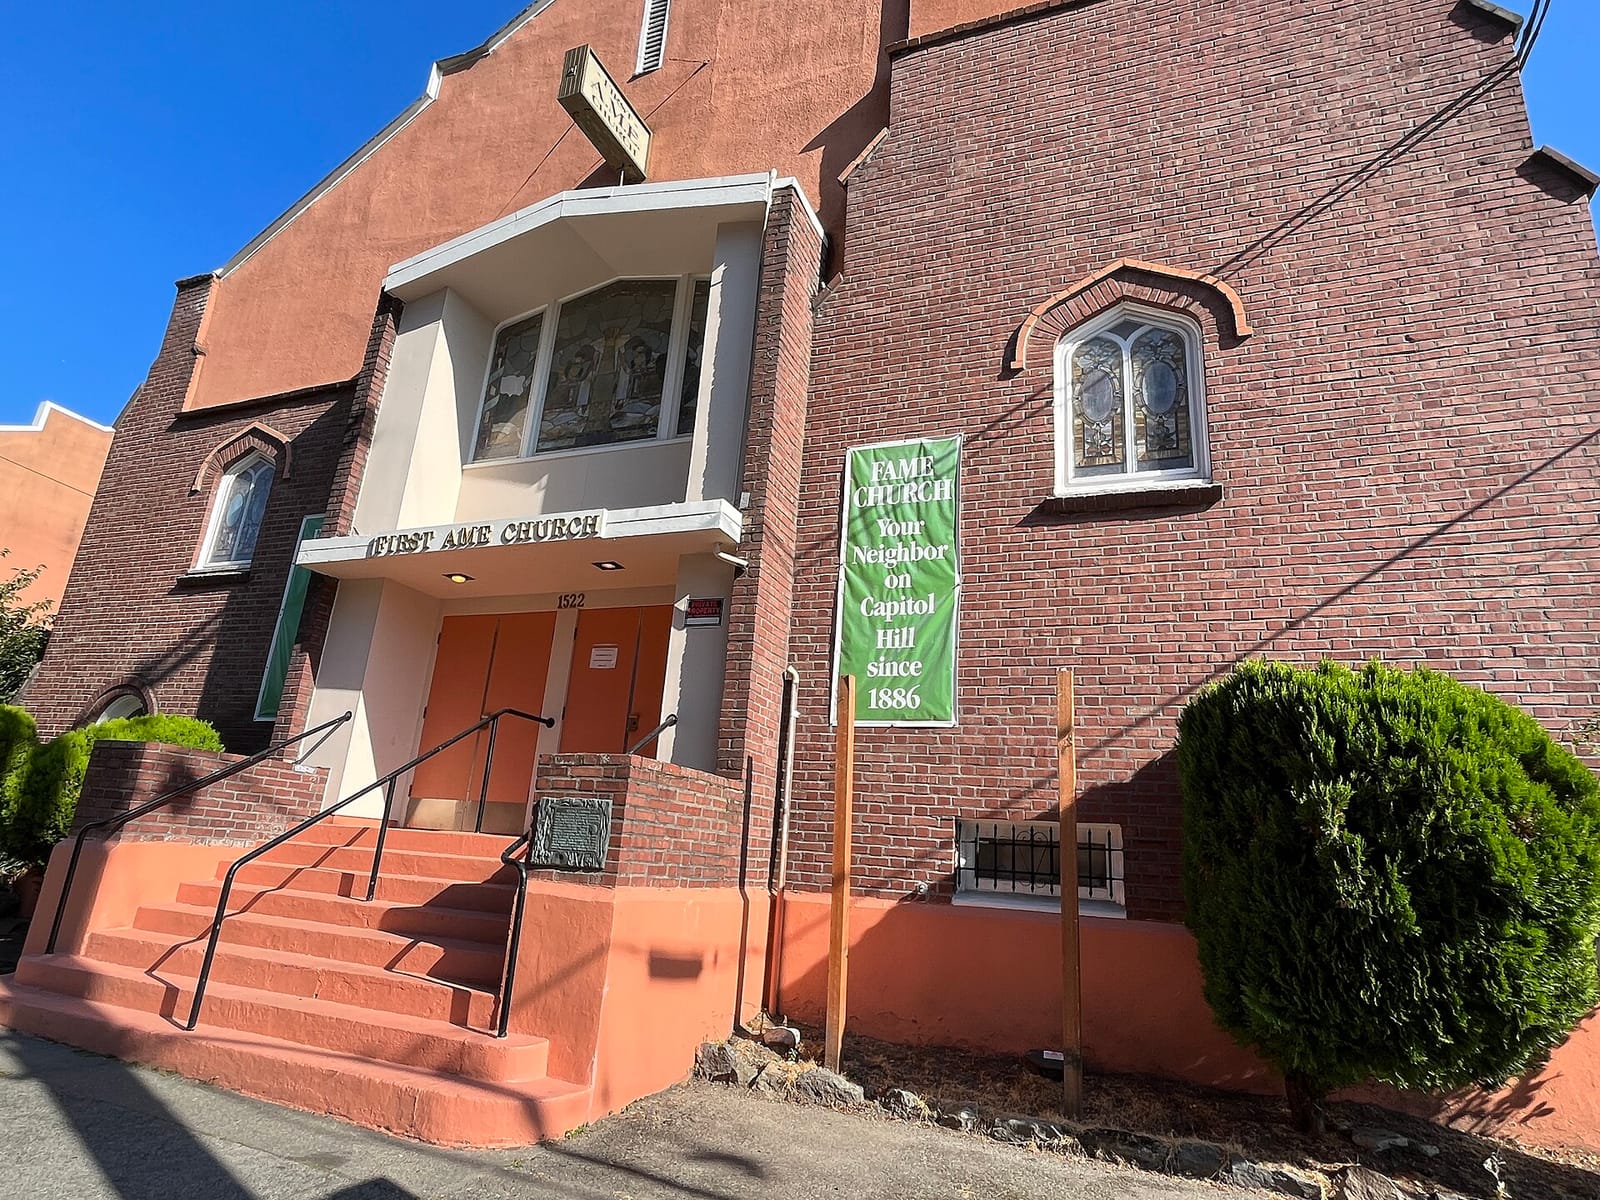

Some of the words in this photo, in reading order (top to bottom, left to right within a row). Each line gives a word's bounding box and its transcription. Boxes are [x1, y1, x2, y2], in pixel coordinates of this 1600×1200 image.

[871, 456, 935, 481] FAME
[853, 478, 953, 508] CHURCH
[372, 531, 434, 556] FIRST
[501, 515, 600, 545] CHURCH
[877, 518, 925, 538] Your
[852, 541, 949, 569] Neighbor
[884, 573, 912, 589] on
[557, 593, 585, 609] 1522
[860, 593, 936, 623] Capitol
[876, 626, 916, 650] Hill
[866, 656, 923, 678] since
[867, 684, 921, 710] 1886
